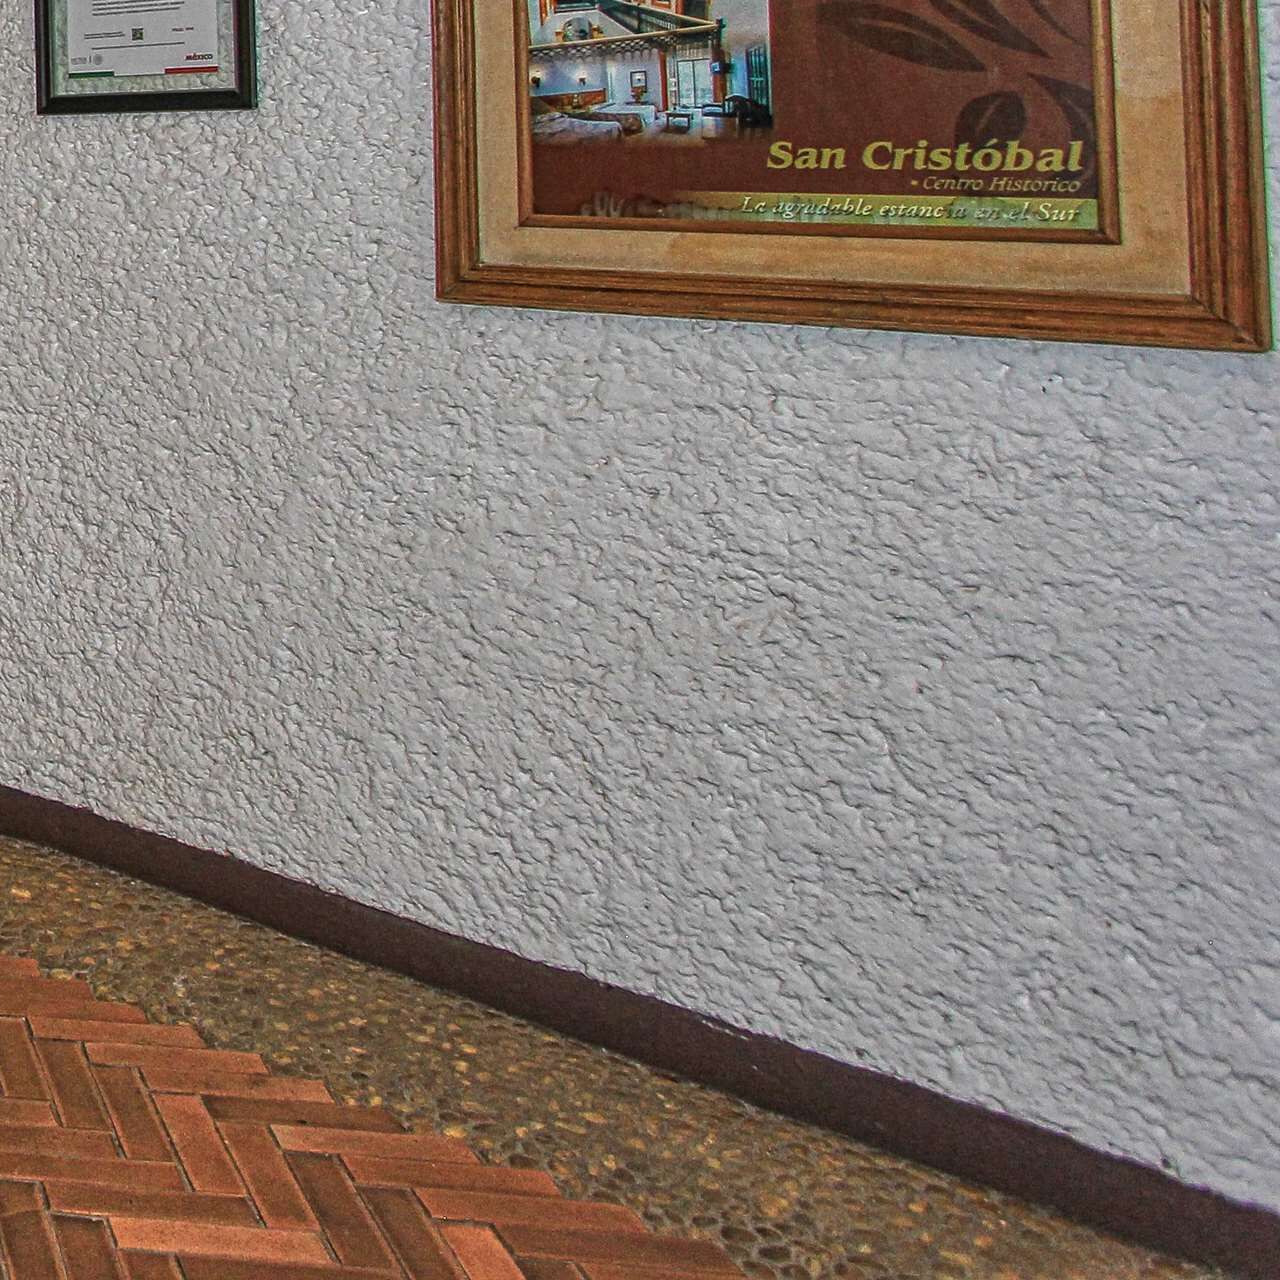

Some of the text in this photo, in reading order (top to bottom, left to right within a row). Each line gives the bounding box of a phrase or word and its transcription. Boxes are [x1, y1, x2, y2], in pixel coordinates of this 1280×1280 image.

[767, 138, 1083, 172] San Cristóbal
[923, 176, 983, 192] Centro
[741, 196, 767, 213] La
[772, 197, 872, 219] agradable
[1037, 202, 1080, 222] Sur
